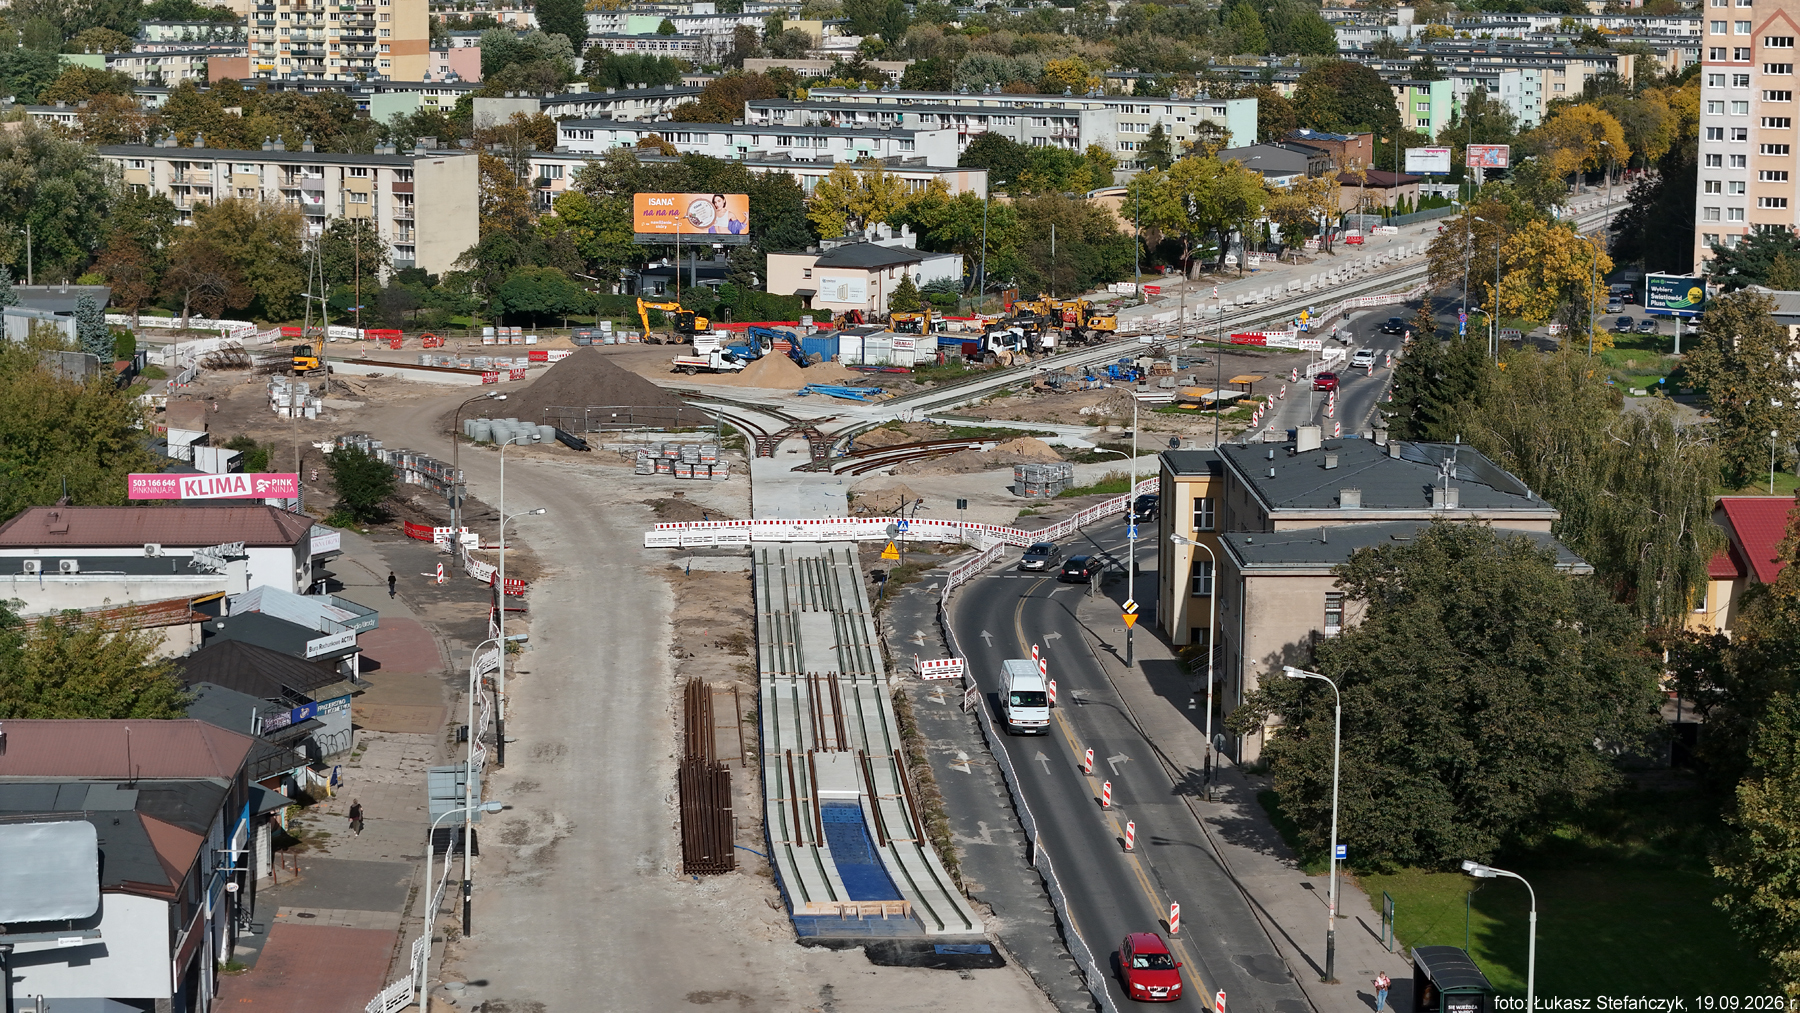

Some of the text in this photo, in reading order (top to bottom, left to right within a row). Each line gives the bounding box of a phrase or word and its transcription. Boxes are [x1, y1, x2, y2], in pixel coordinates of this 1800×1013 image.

[643, 209, 680, 217] na na na
[185, 476, 247, 496] KLIMA
[308, 644, 318, 652] Biuro
[341, 635, 354, 644] ACTIV
